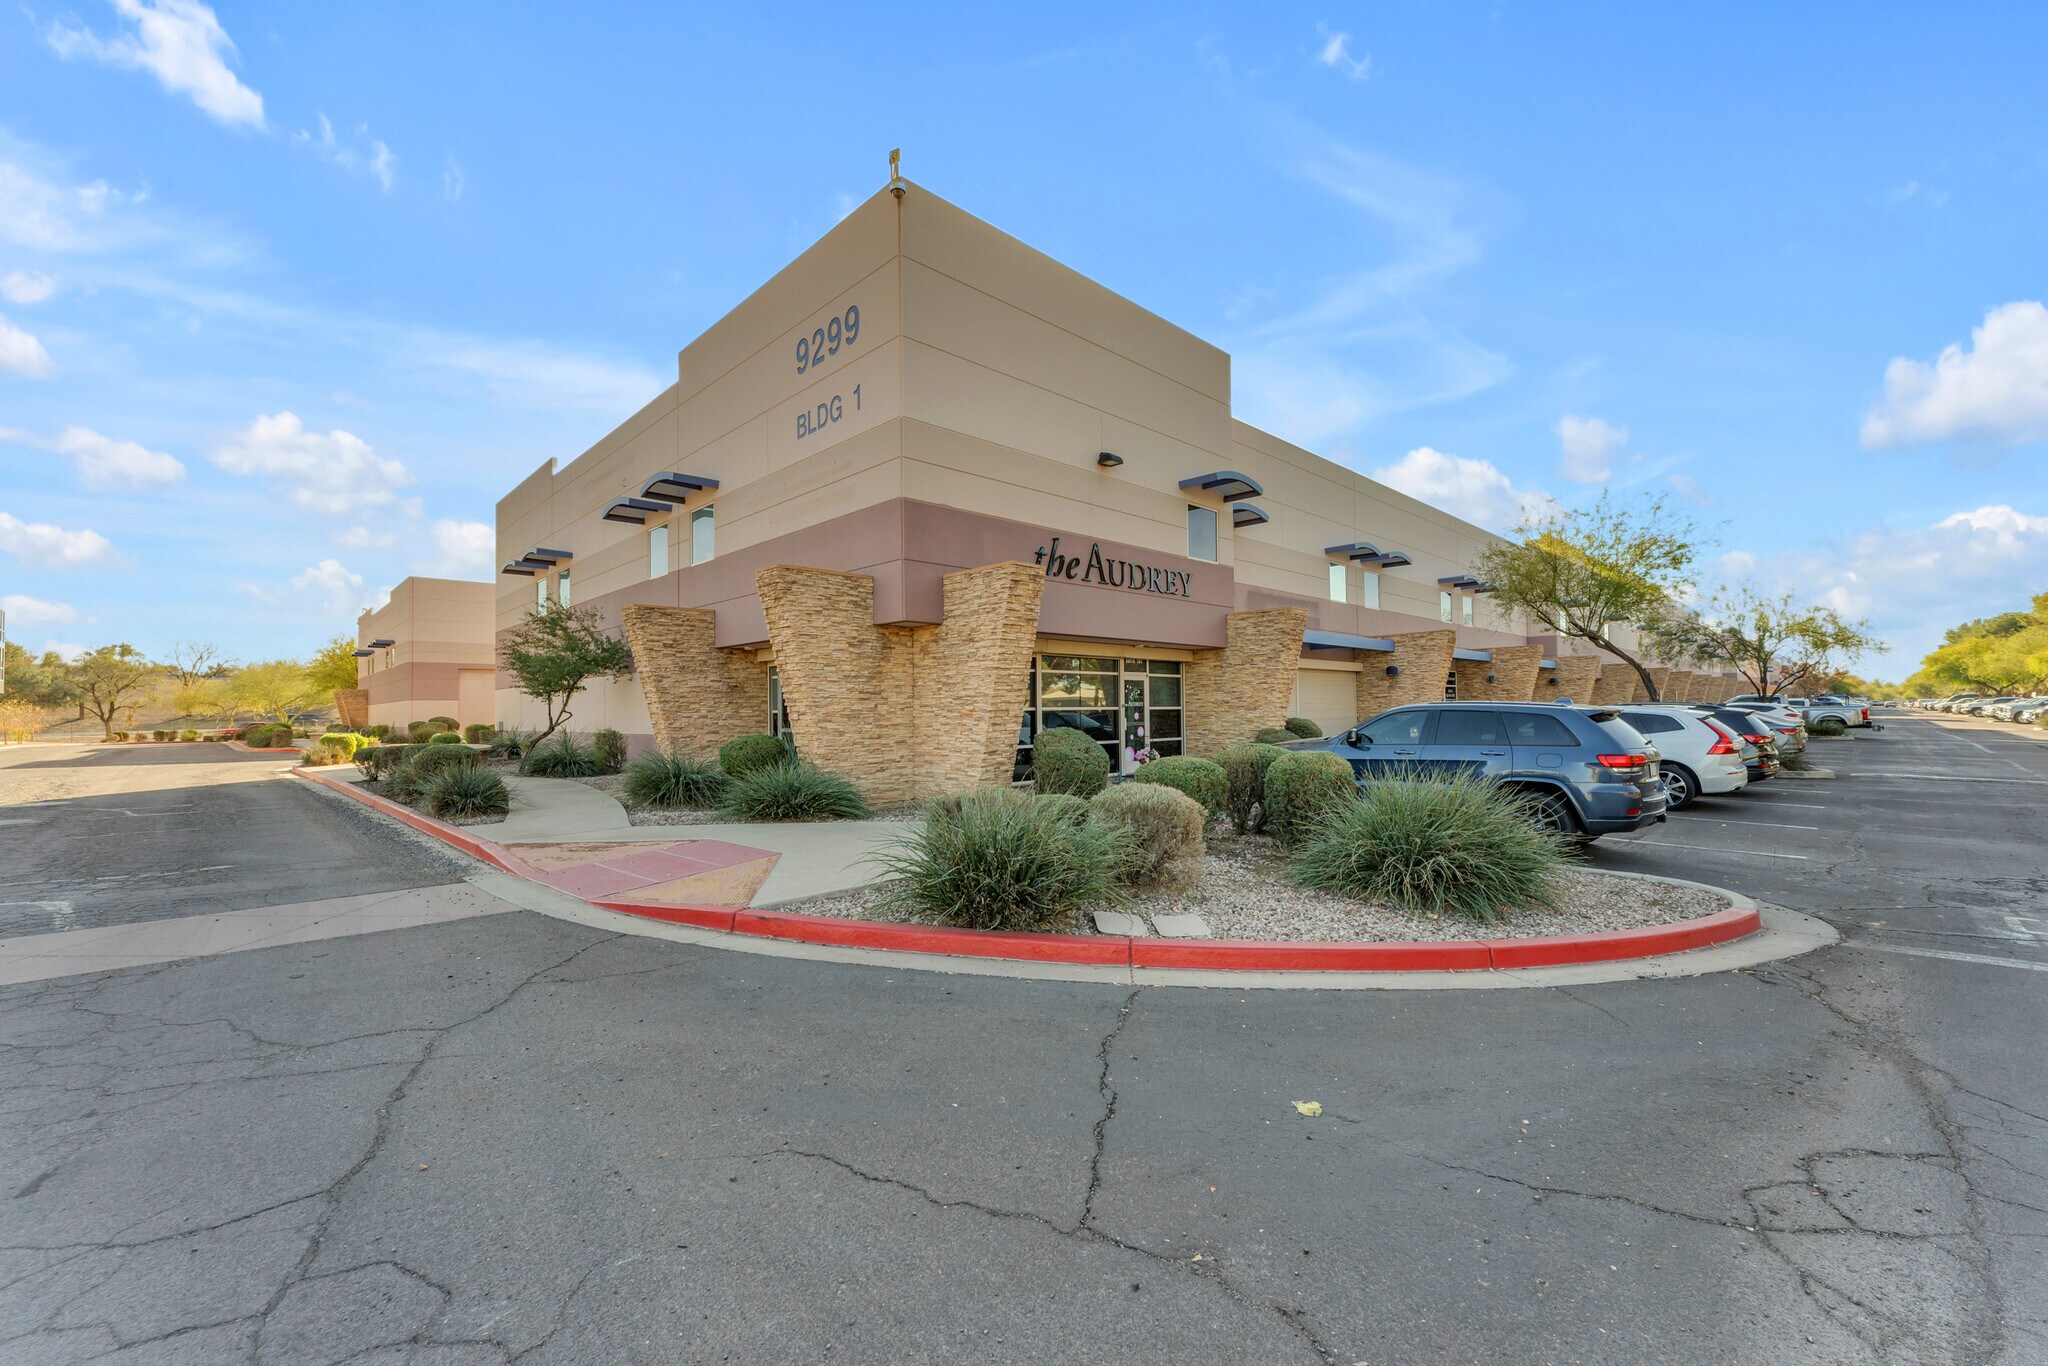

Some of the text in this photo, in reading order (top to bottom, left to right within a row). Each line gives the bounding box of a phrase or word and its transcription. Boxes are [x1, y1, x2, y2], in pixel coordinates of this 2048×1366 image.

[796, 305, 860, 375] 9299
[797, 383, 861, 440] BLDG 1
[1035, 537, 1193, 597] the AUDREY
